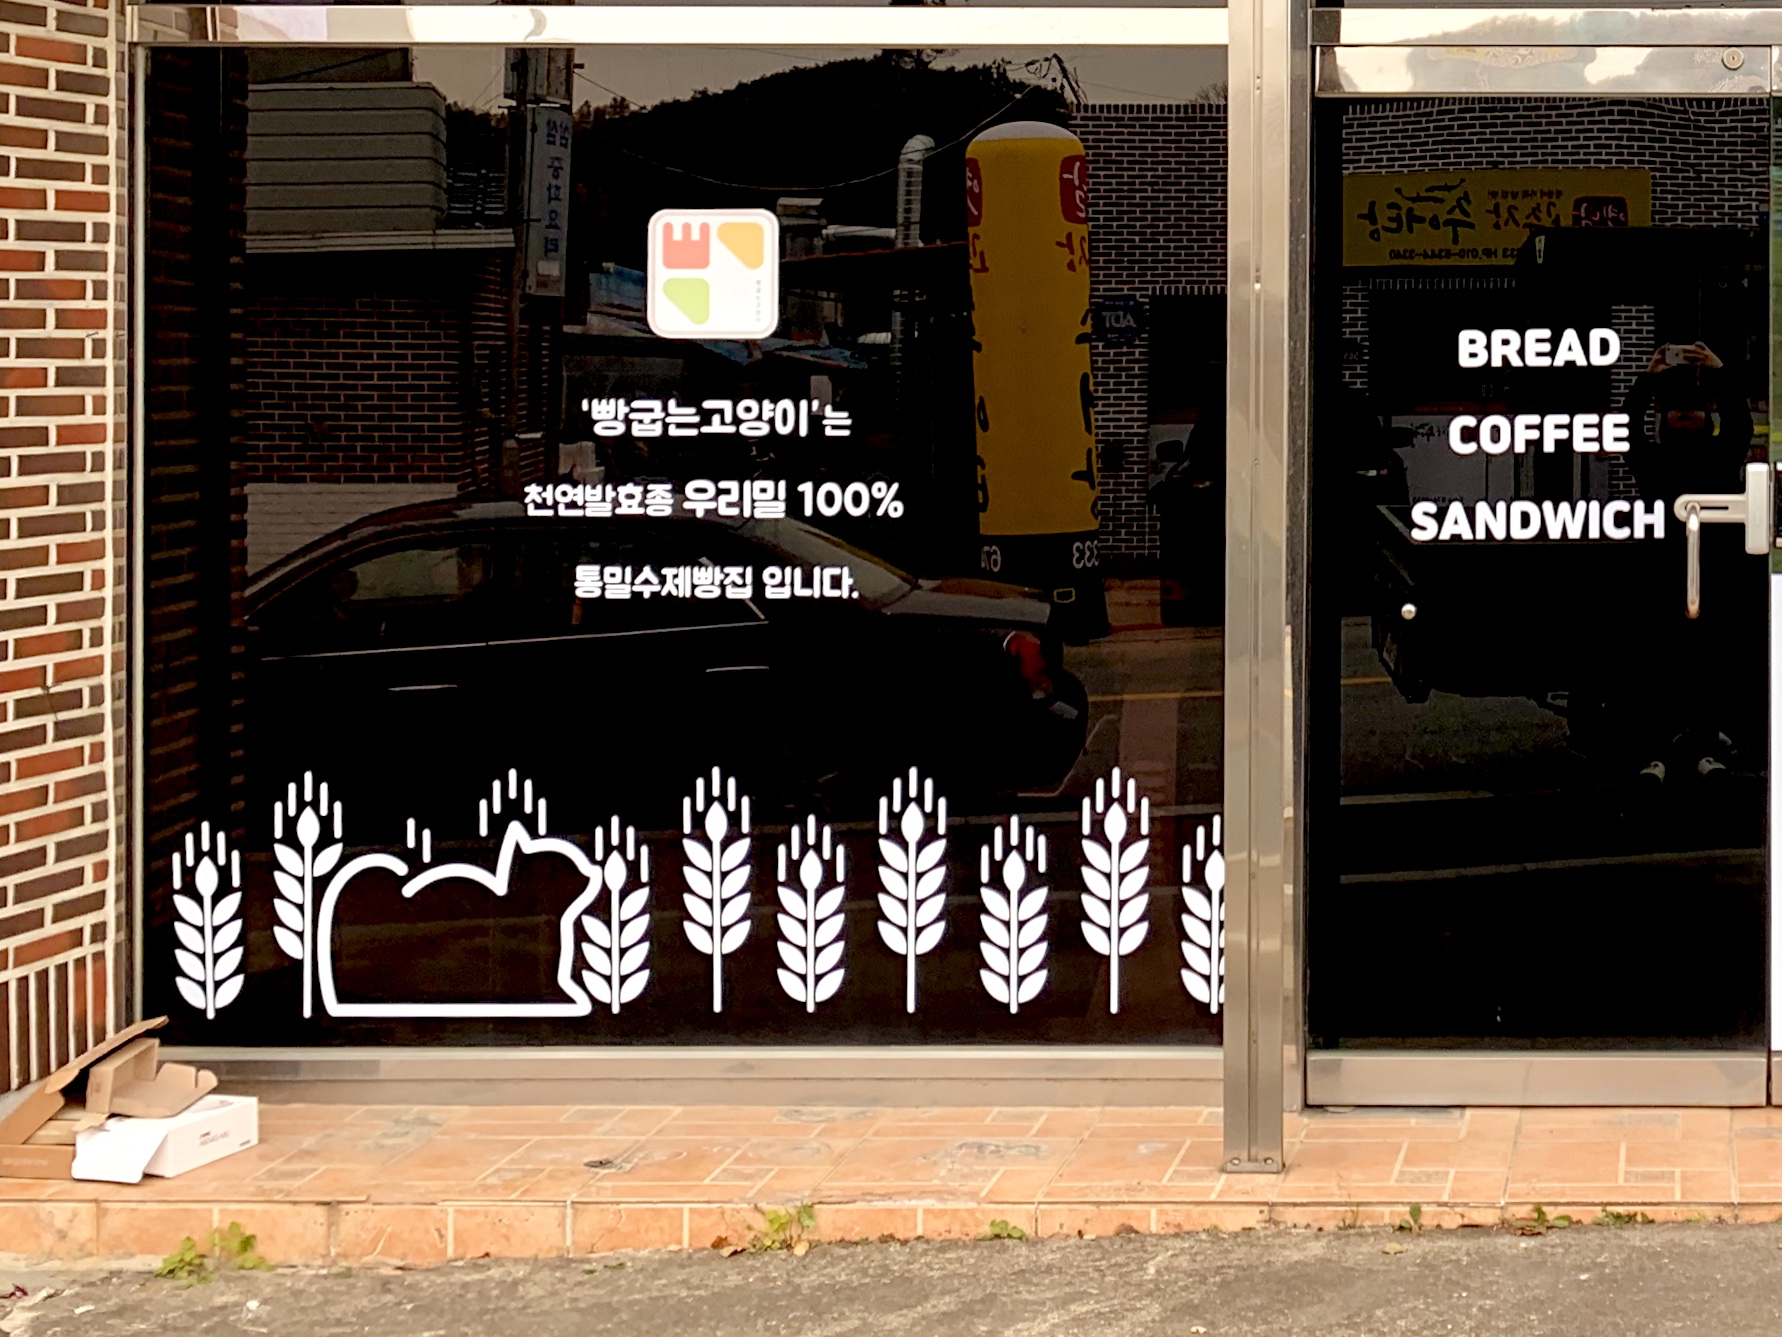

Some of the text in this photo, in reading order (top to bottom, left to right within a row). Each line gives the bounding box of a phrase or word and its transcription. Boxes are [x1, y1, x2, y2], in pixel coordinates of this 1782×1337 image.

[1458, 327, 1622, 369] BREAD
[1448, 414, 1631, 455] COFFEE
[523, 480, 905, 520] 천연발효종 우리밀 100%
[1410, 500, 1666, 542] SANDWICH
[573, 565, 860, 600] 통밀수제빵집 입니다.
